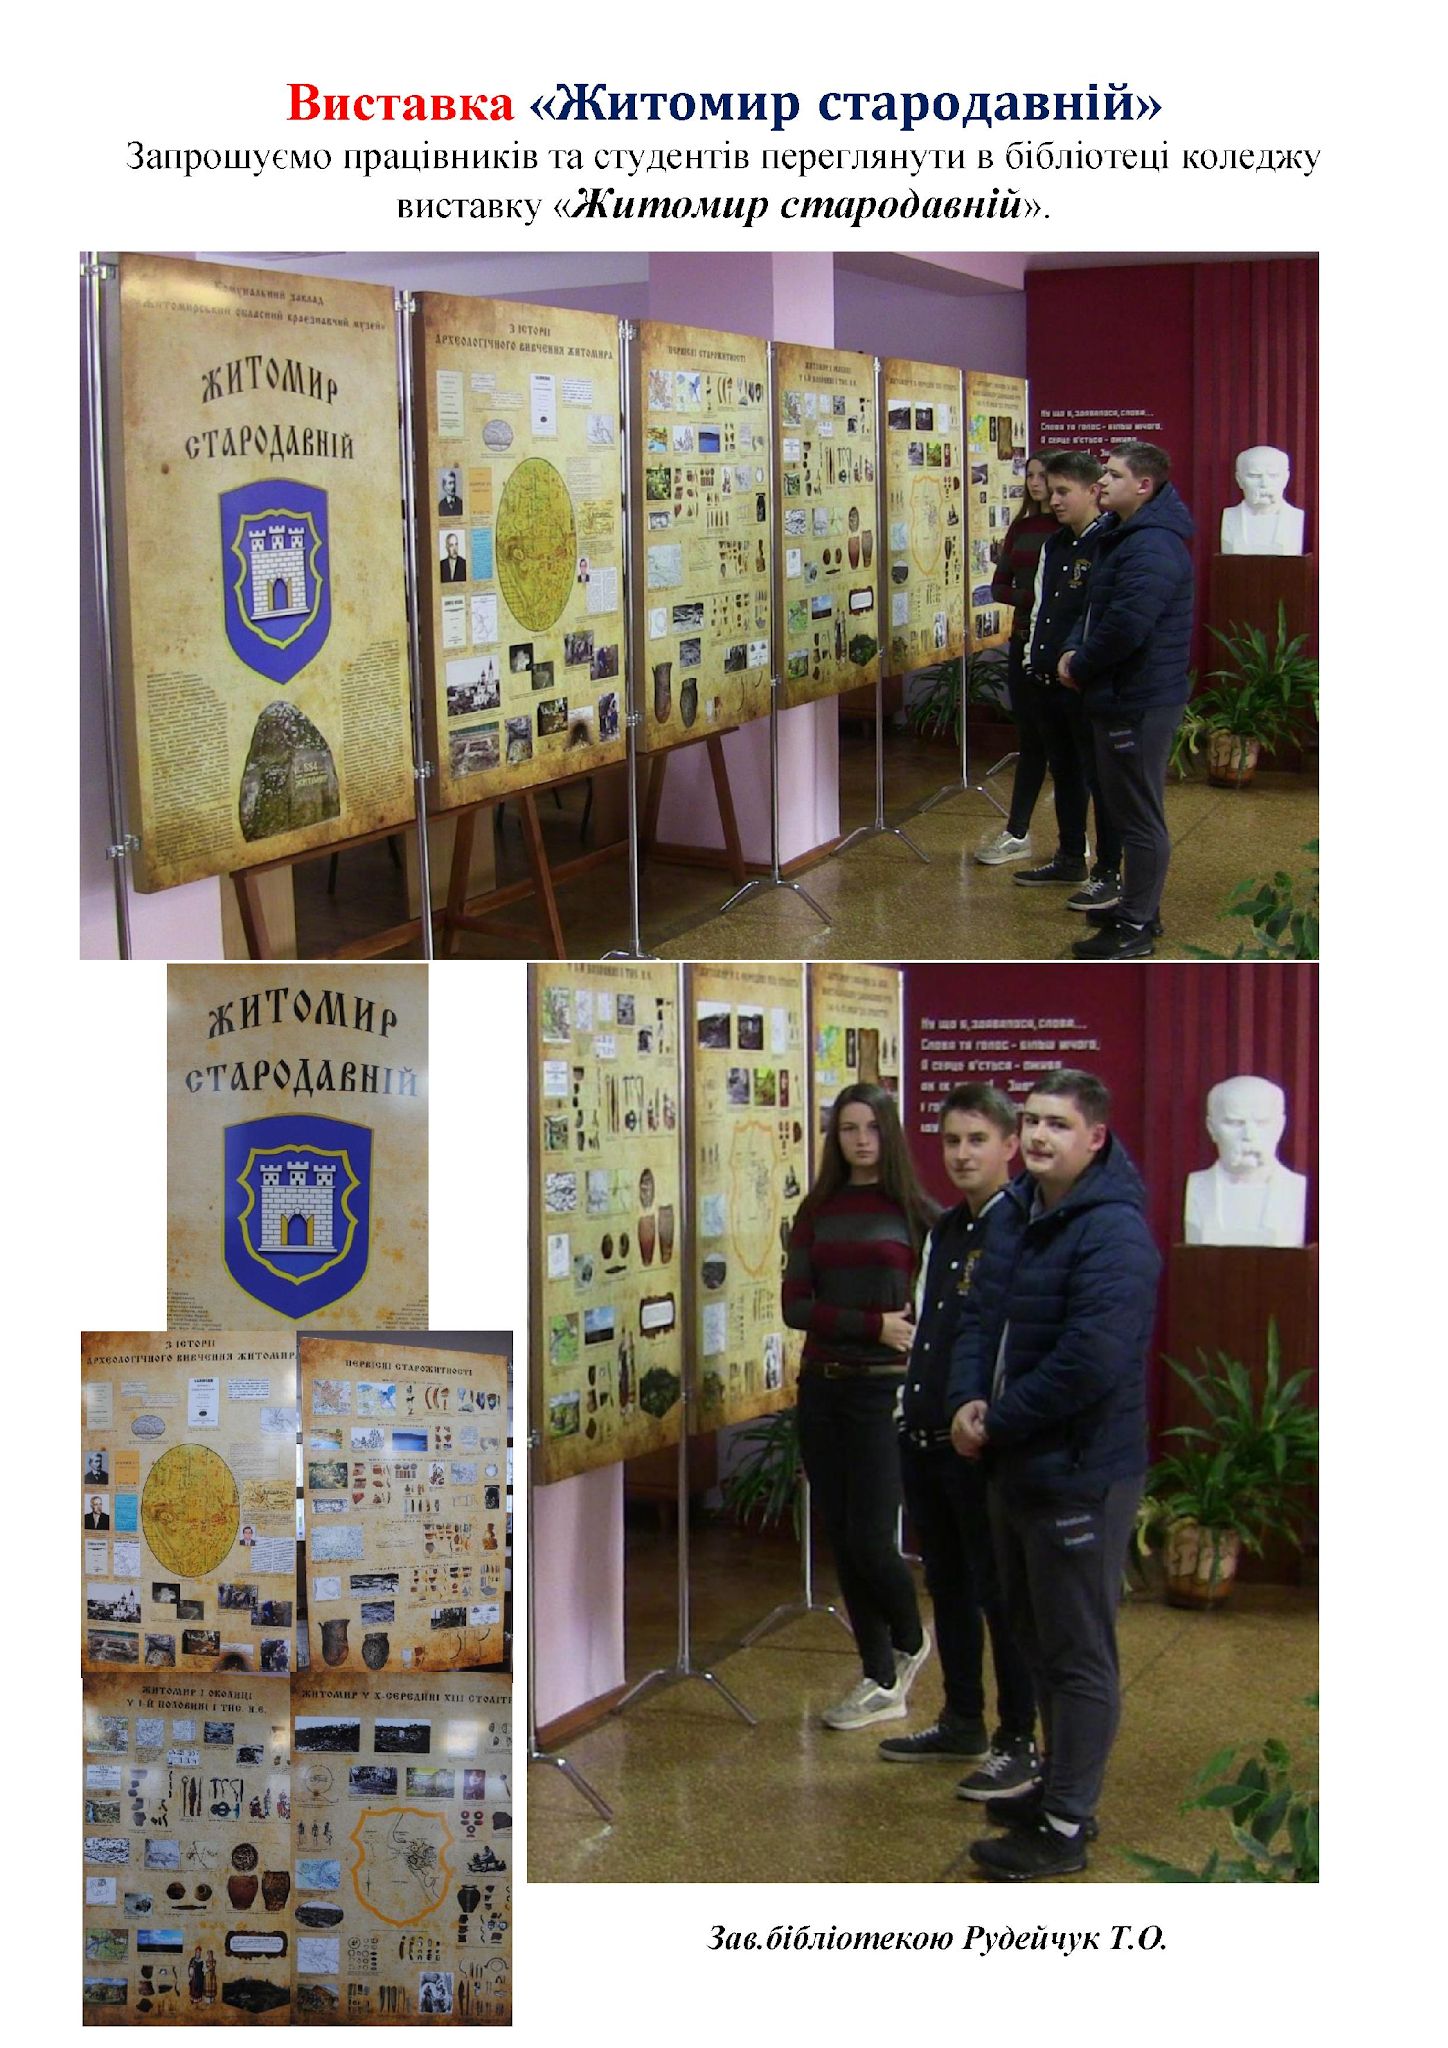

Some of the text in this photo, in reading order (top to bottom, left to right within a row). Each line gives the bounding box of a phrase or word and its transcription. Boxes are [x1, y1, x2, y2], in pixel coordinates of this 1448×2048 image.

[201, 355, 339, 404] ЖИТОМИР
[185, 424, 355, 462] СТАРОДАВНІЙ
[207, 986, 398, 1040] ЖИТОМИР
[184, 1058, 419, 1098] СТАРОДАВНІЙ
[142, 1685, 197, 1697] ЖИТОМИР
[302, 1690, 358, 1700] ЖИТОМИР
